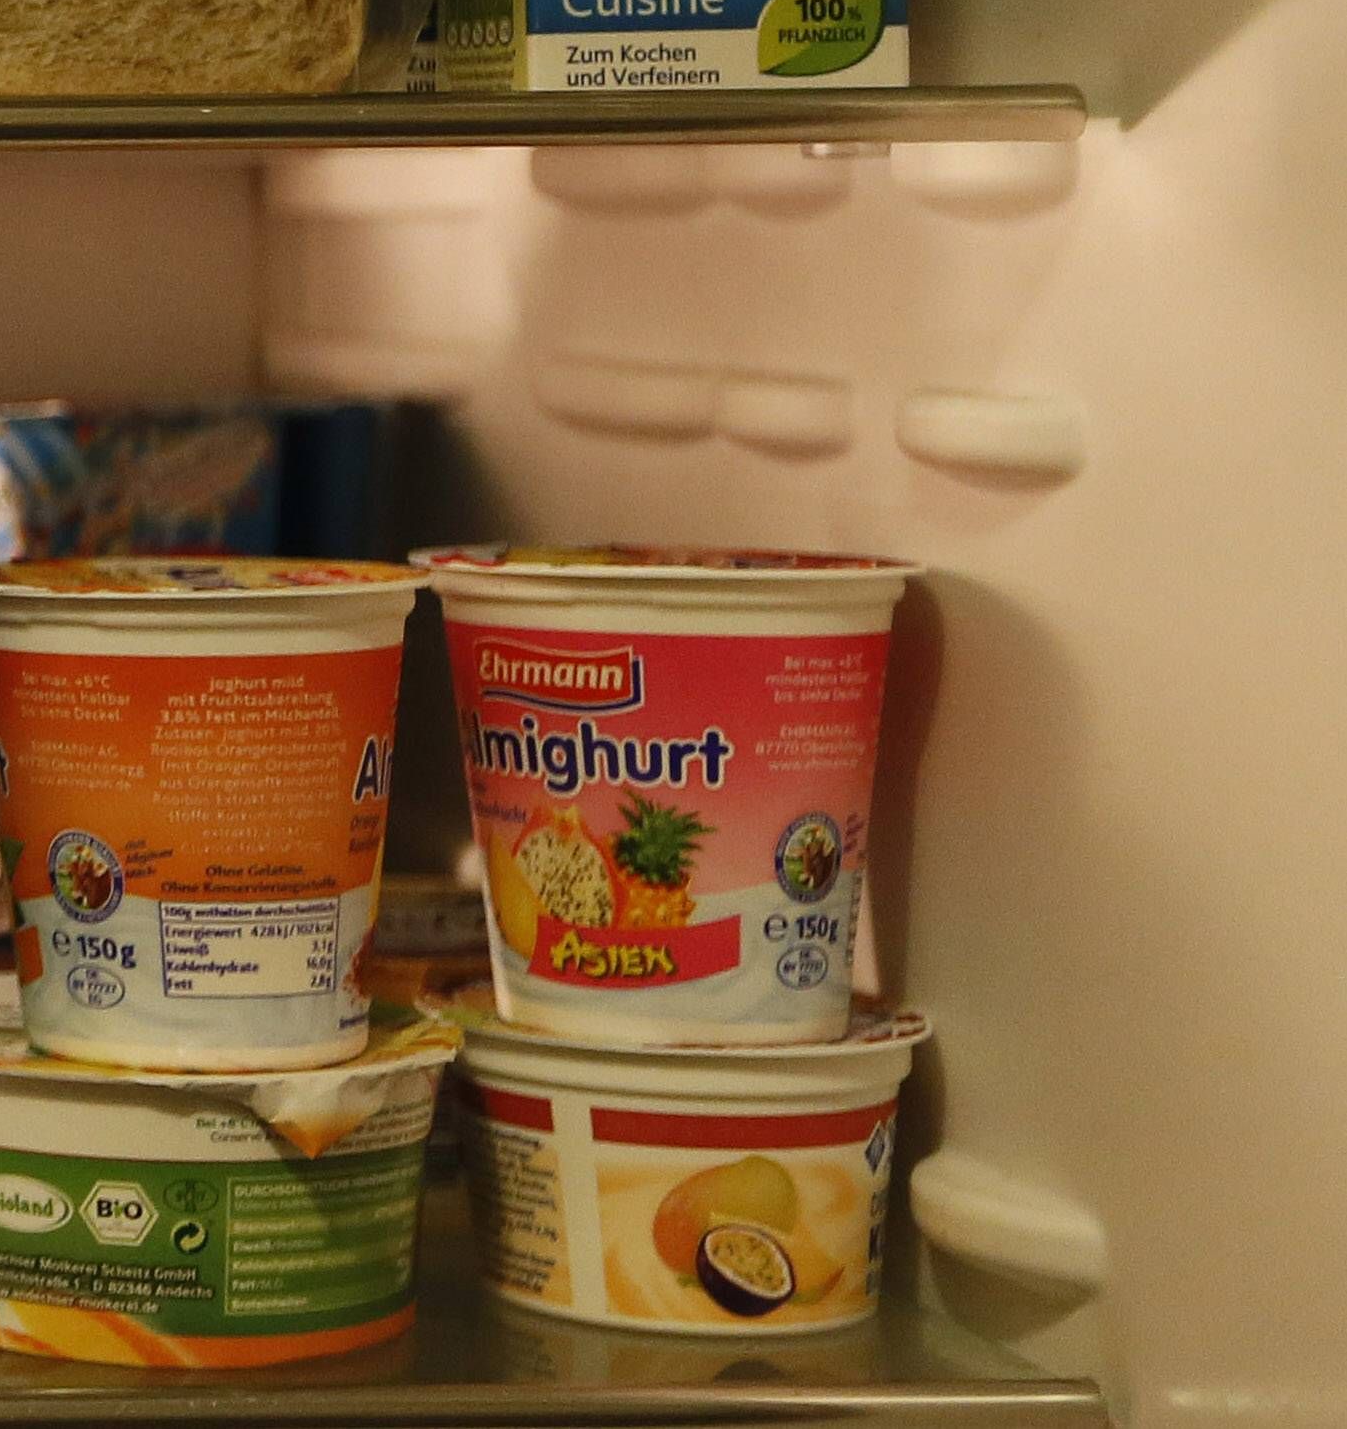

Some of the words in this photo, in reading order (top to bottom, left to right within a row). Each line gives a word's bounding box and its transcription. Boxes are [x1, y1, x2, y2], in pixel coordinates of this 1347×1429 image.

[777, 26, 866, 43] PFLANZLICH
[566, 44, 614, 65] Zum
[620, 42, 697, 62] Kochen
[566, 70, 606, 87] und
[613, 67, 721, 85] Verfeinern
[477, 649, 625, 692] Ehrmann
[465, 708, 734, 797] lmighurt
[76, 934, 138, 970] 150g
